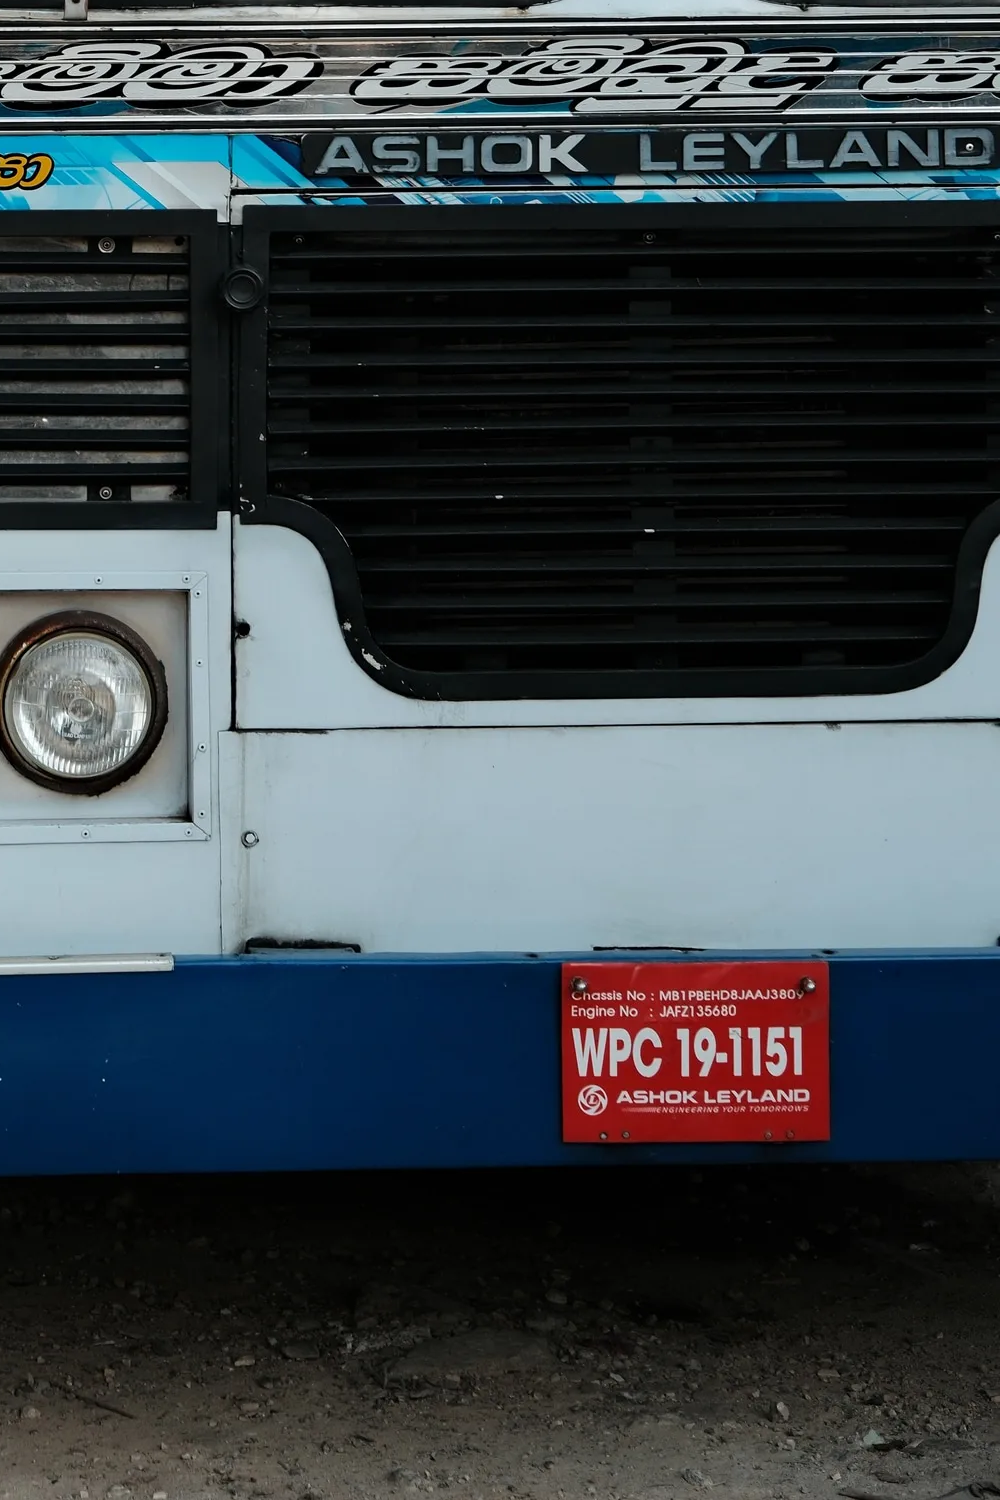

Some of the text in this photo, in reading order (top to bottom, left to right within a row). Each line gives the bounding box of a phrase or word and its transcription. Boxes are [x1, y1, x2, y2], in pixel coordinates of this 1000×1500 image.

[315, 128, 994, 174] ASHOK LEYLAND
[571, 990, 622, 1001] Chassis
[626, 989, 646, 1001] No
[571, 1005, 616, 1020] Engine
[619, 1005, 638, 1017] No
[659, 1005, 737, 1018] JAFZ135680
[571, 1026, 803, 1077] WPC 19-1151
[616, 1088, 811, 1104] ASHOK LEYLAND
[655, 1106, 720, 1114] ENGINEERING
[749, 1105, 810, 1113] TOMORROWS
